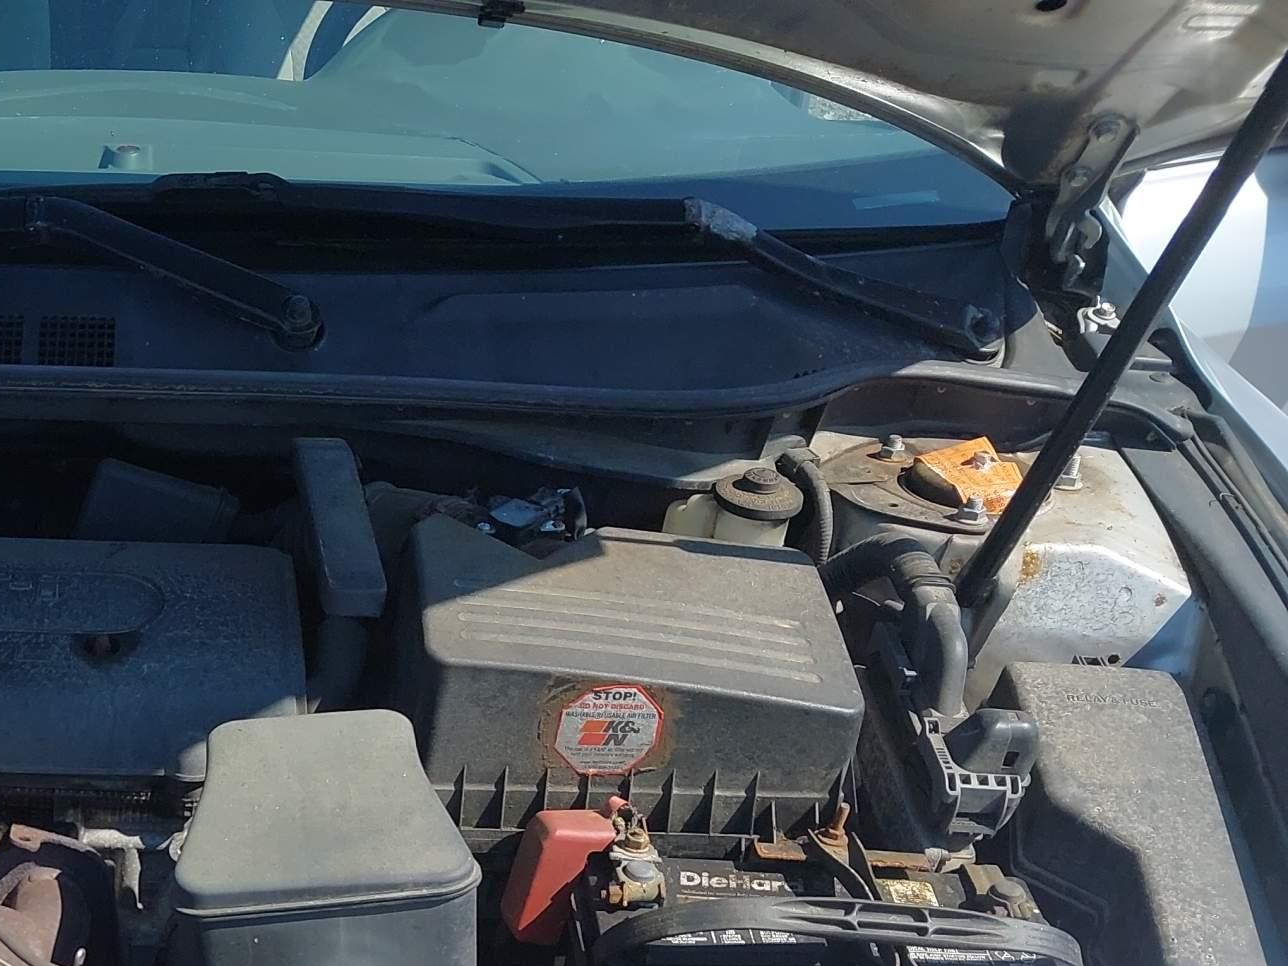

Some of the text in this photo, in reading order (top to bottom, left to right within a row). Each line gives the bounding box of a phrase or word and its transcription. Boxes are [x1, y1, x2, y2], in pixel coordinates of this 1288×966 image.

[592, 691, 637, 701] STOP!
[593, 703, 608, 711] NOT
[610, 703, 645, 711] DISCARD
[626, 712, 637, 720] AIR
[637, 712, 657, 720] FILTER
[603, 733, 629, 746] N
[680, 870, 804, 892] DieHard
